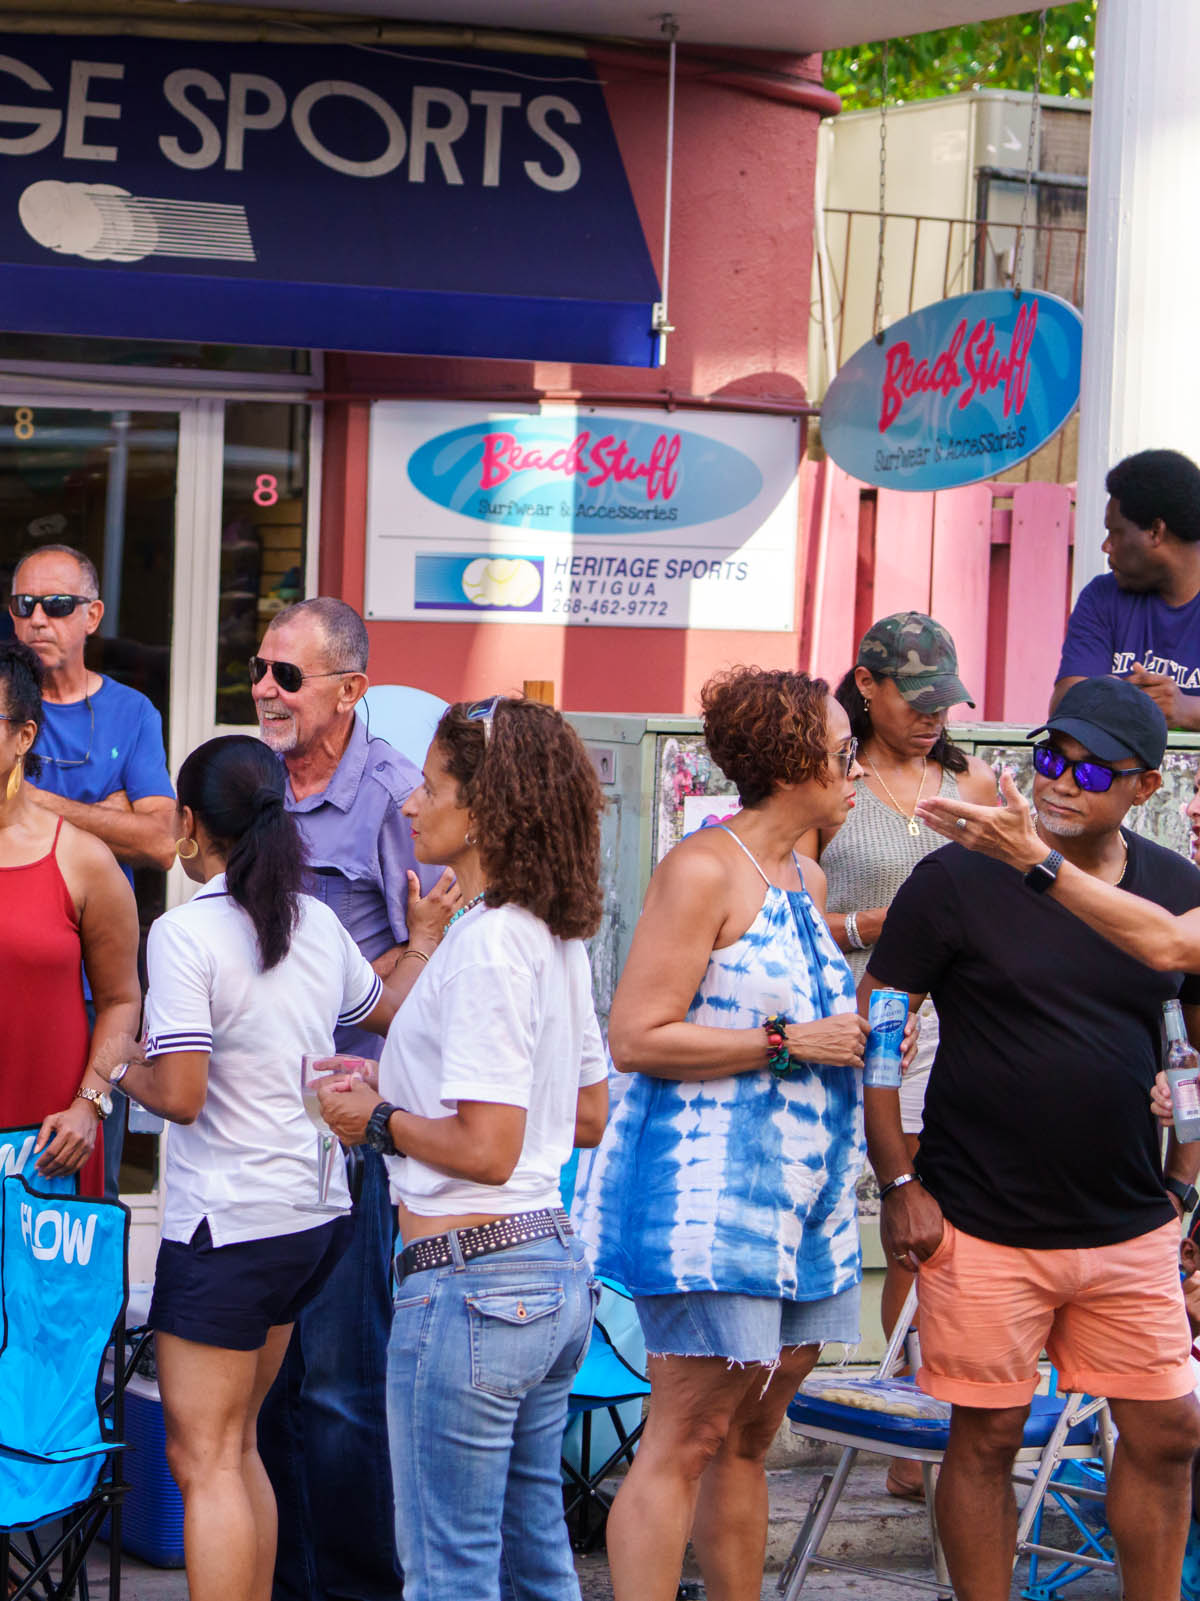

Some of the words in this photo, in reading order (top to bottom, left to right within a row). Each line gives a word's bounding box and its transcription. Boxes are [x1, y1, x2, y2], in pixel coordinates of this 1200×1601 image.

[158, 68, 583, 194] SPORTS
[878, 318, 967, 434] Beach
[958, 299, 1038, 418] Stuff
[14, 407, 35, 440] 8
[479, 431, 590, 490] Beach
[587, 434, 681, 501] Stuff
[874, 446, 930, 472] Surfwear
[945, 425, 1027, 460] Accessories
[253, 474, 279, 507] 8
[478, 498, 553, 517] Surfwear
[560, 502, 571, 517] &
[575, 503, 679, 521] Accessories
[554, 555, 660, 578] HERITAGE
[664, 559, 750, 581] SPORTS
[553, 579, 657, 596] ANTIGUA
[552, 598, 669, 617] 268-462-9772
[1143, 649, 1200, 689] LUIA
[20, 1202, 98, 1266] FLOW
